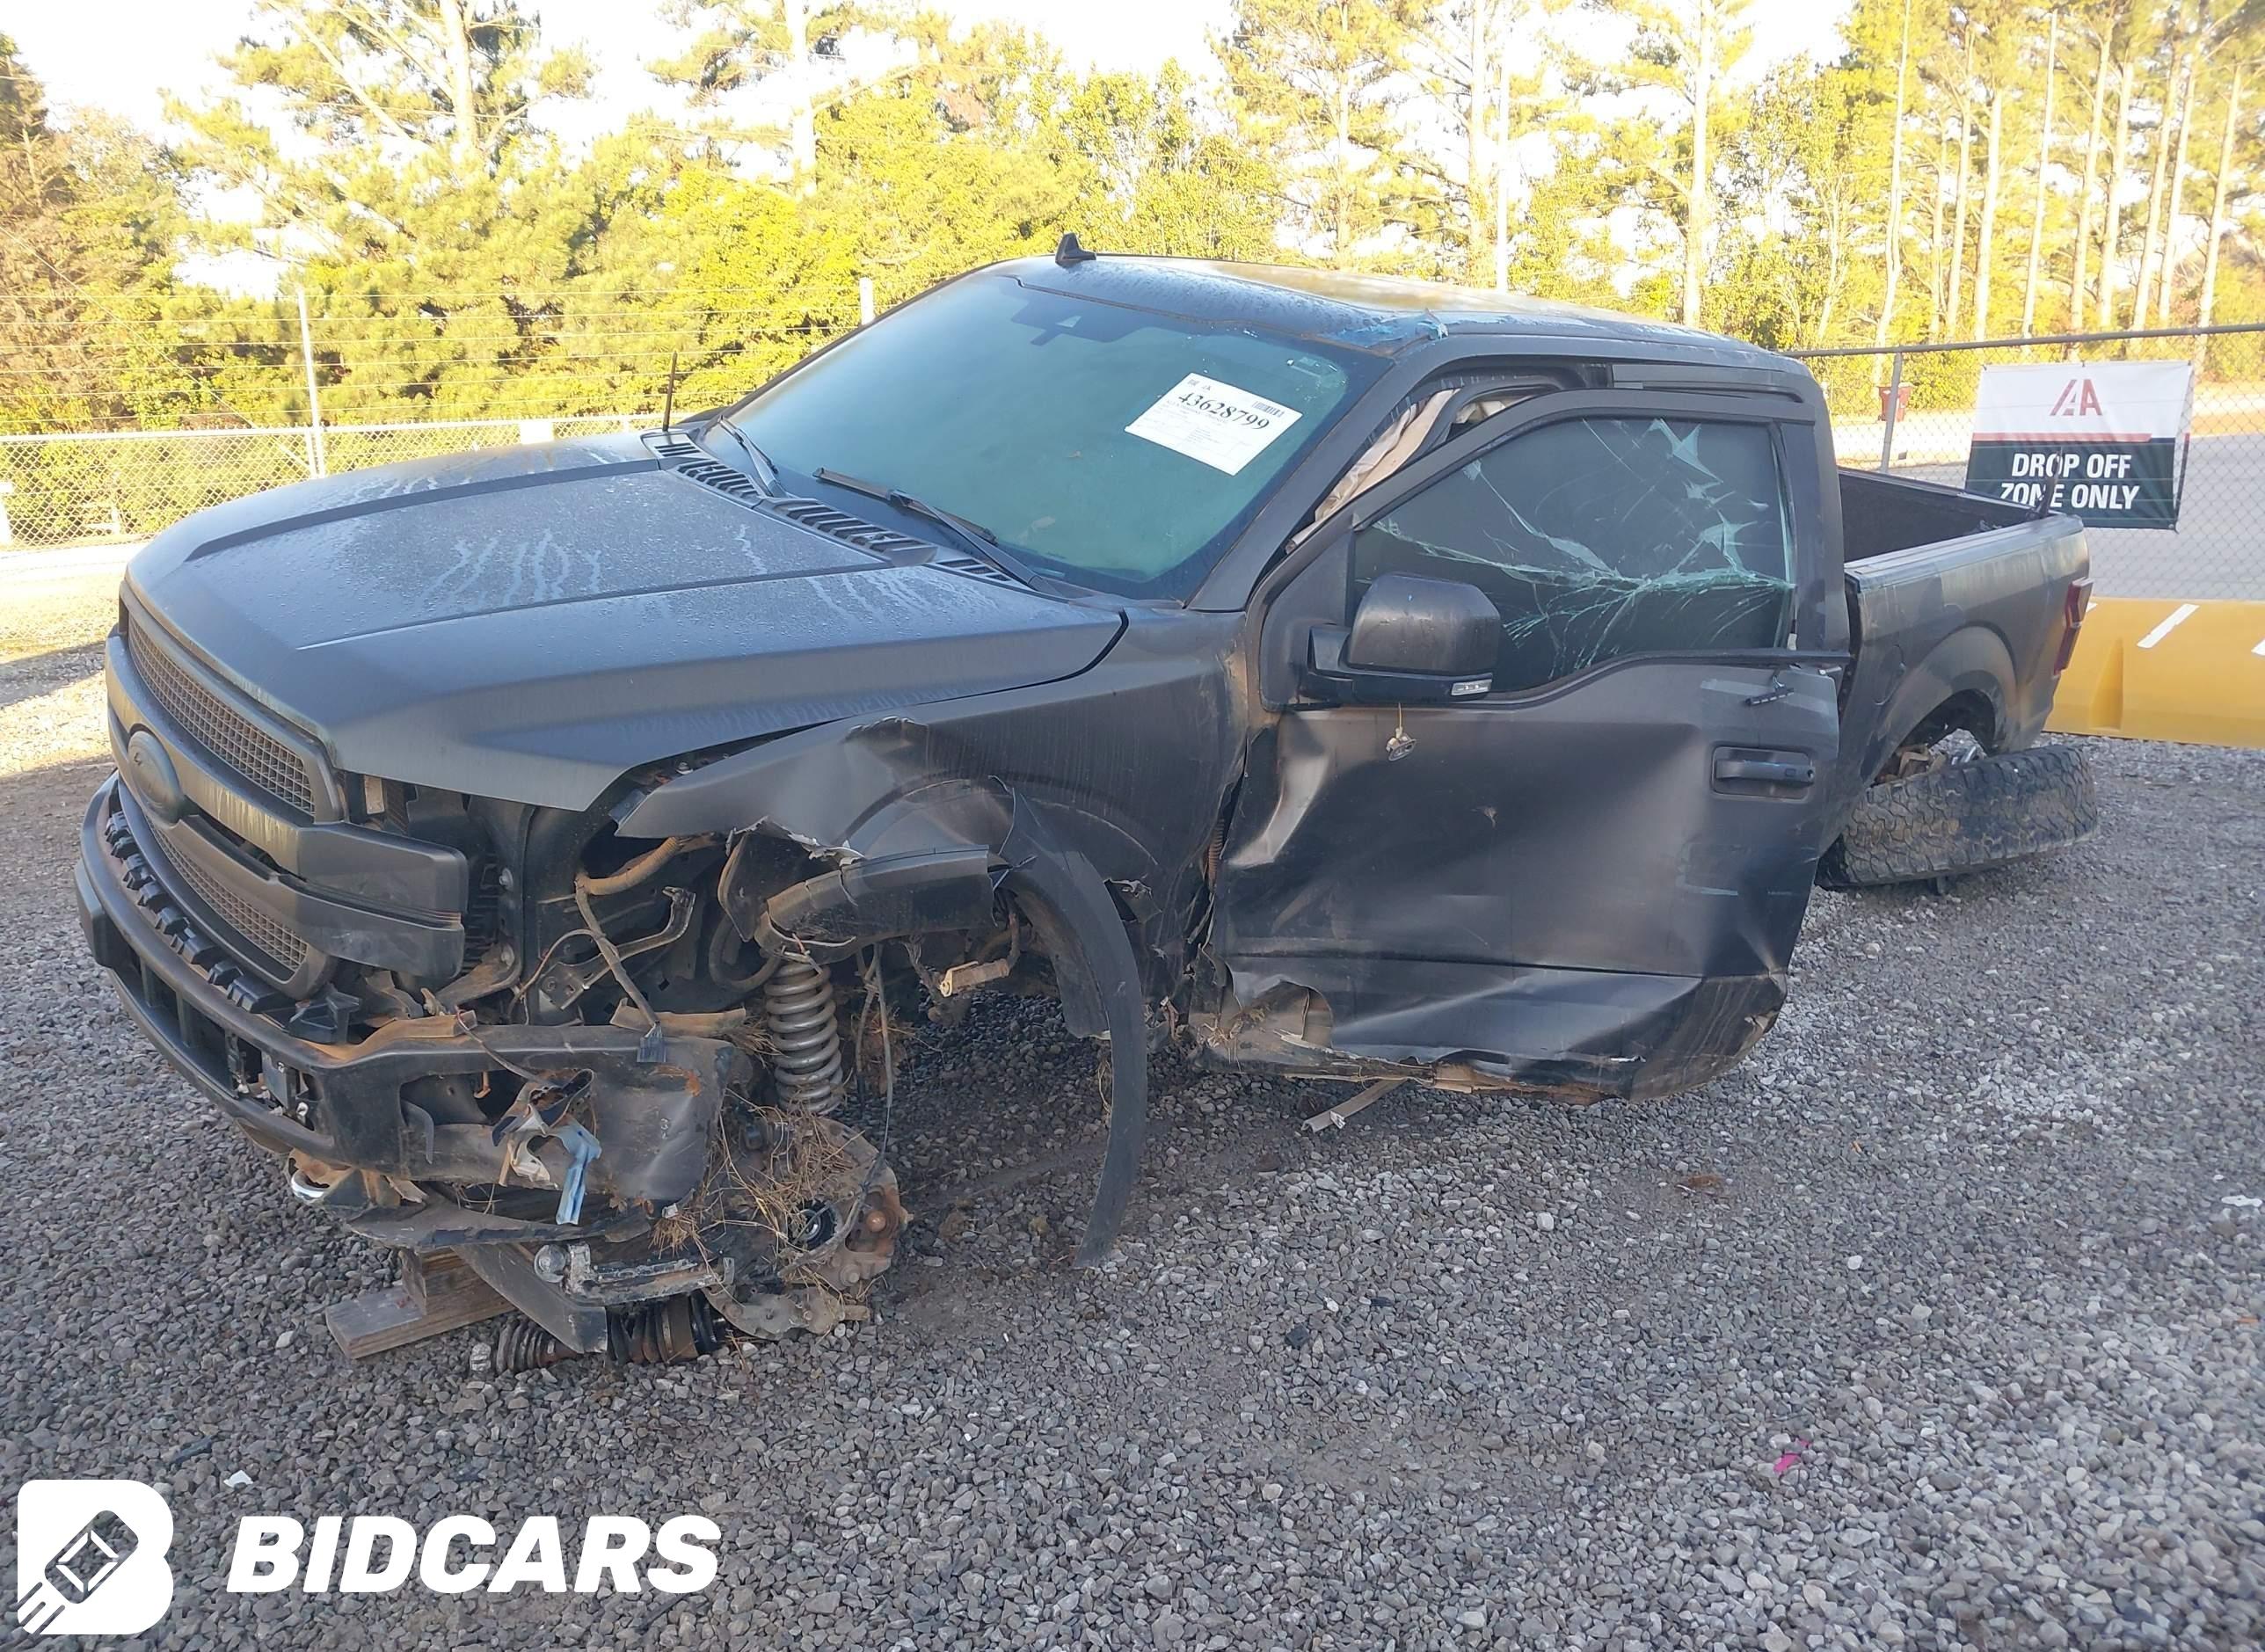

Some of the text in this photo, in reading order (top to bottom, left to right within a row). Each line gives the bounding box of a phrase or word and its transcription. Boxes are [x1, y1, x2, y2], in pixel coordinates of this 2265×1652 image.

[1178, 392, 1270, 430] 43628799
[2012, 453, 2132, 478] DROP OFF
[2071, 484, 2140, 509] ONLY
